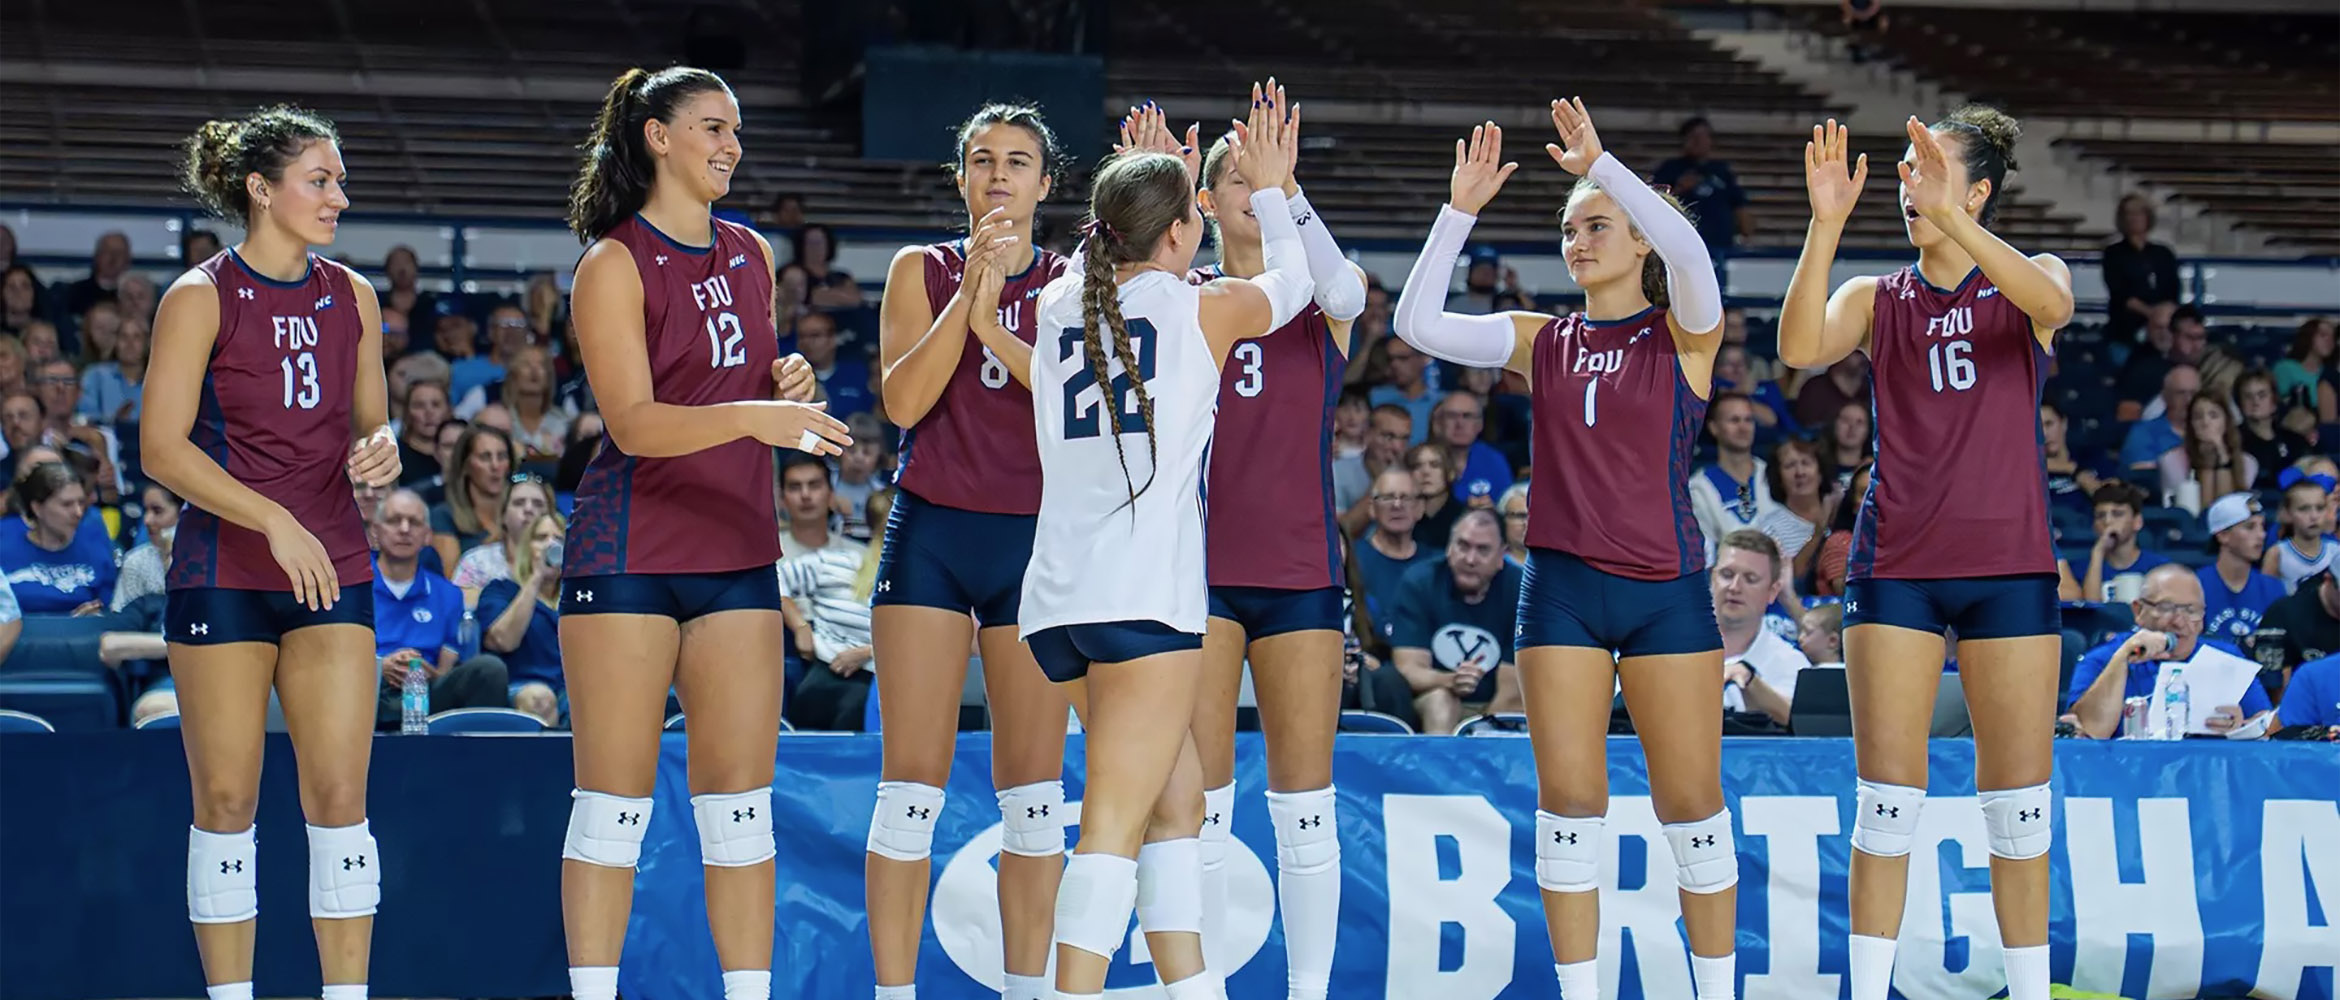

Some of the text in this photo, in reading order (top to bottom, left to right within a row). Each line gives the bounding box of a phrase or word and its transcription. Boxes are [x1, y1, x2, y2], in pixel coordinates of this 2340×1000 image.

[729, 253, 746, 269] NEC
[691, 275, 732, 311] FDU
[1026, 288, 1042, 299] NE
[272, 316, 318, 349] FDU
[706, 312, 746, 369] 12
[1926, 307, 1974, 337] FDU
[281, 352, 320, 409] 13
[1059, 317, 1157, 440] 22
[1234, 342, 1264, 398] 3
[1573, 347, 1623, 373] FDU
[1929, 340, 1977, 393] 16
[1584, 376, 1598, 428] 1
